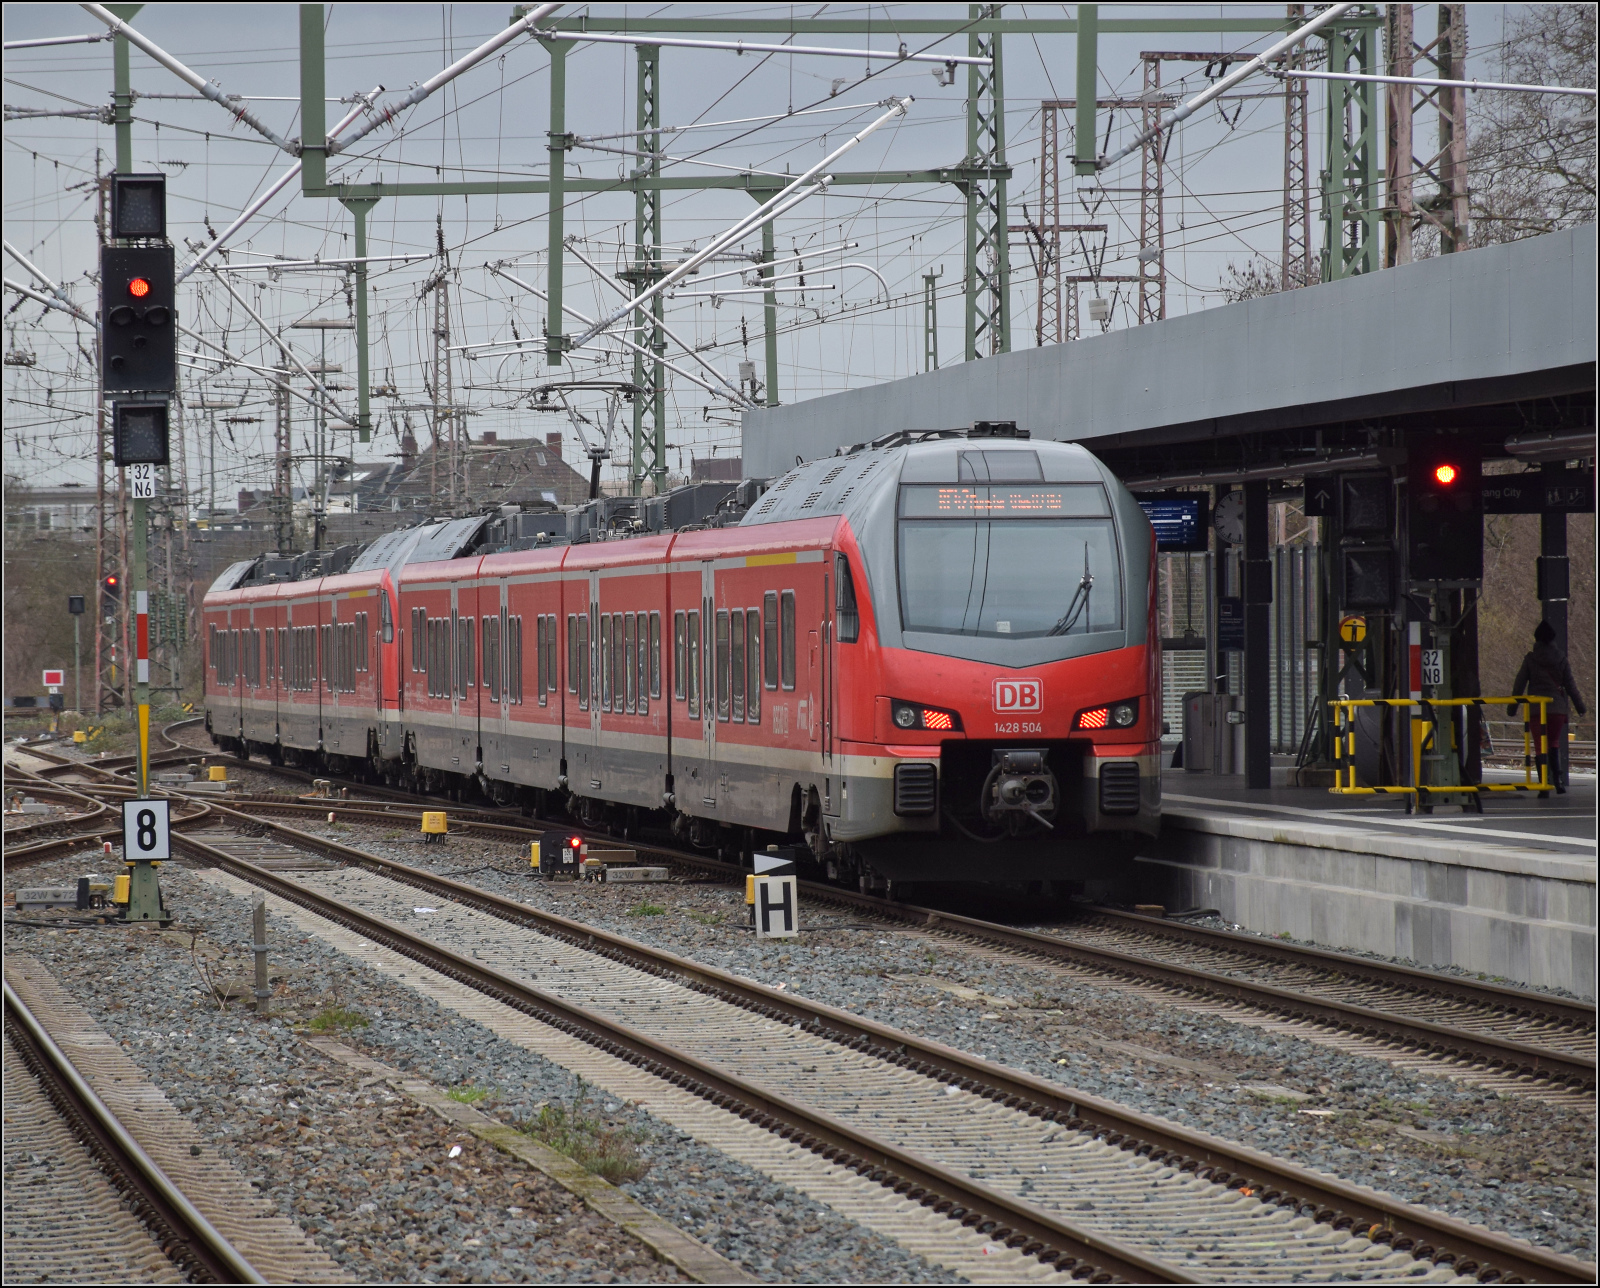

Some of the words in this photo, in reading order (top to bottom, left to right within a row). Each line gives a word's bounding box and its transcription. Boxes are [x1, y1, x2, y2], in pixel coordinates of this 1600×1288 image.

[135, 464, 150, 479] 32
[135, 482, 151, 496] N6
[1503, 488, 1521, 498] City
[1423, 651, 1438, 666] 32
[1423, 669, 1440, 683] N8
[998, 683, 1038, 708] DB
[994, 722, 1019, 733] 1428
[1022, 722, 1042, 733] 504
[136, 808, 157, 851] 8
[613, 871, 635, 879] 32W
[23, 891, 48, 900] 32W
[62, 891, 76, 899] 72
[760, 881, 793, 932] H
